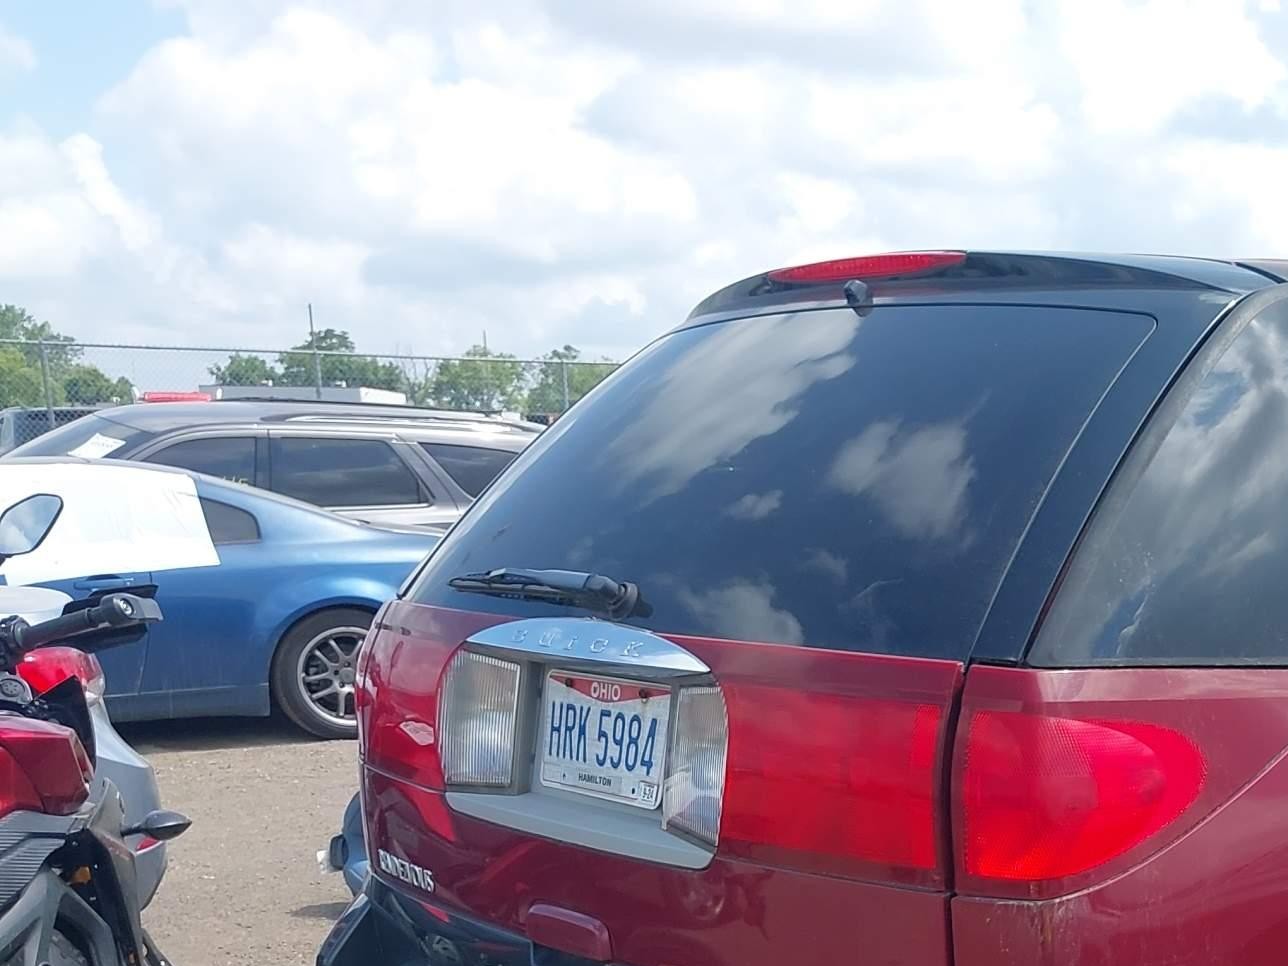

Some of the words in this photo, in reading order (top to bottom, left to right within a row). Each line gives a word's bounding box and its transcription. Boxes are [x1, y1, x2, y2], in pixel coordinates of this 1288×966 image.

[512, 629, 644, 657] BUICK
[590, 681, 621, 701] OHIO
[548, 700, 592, 763] HRK
[595, 708, 658, 776] 5984
[578, 772, 612, 787] HAMILTON
